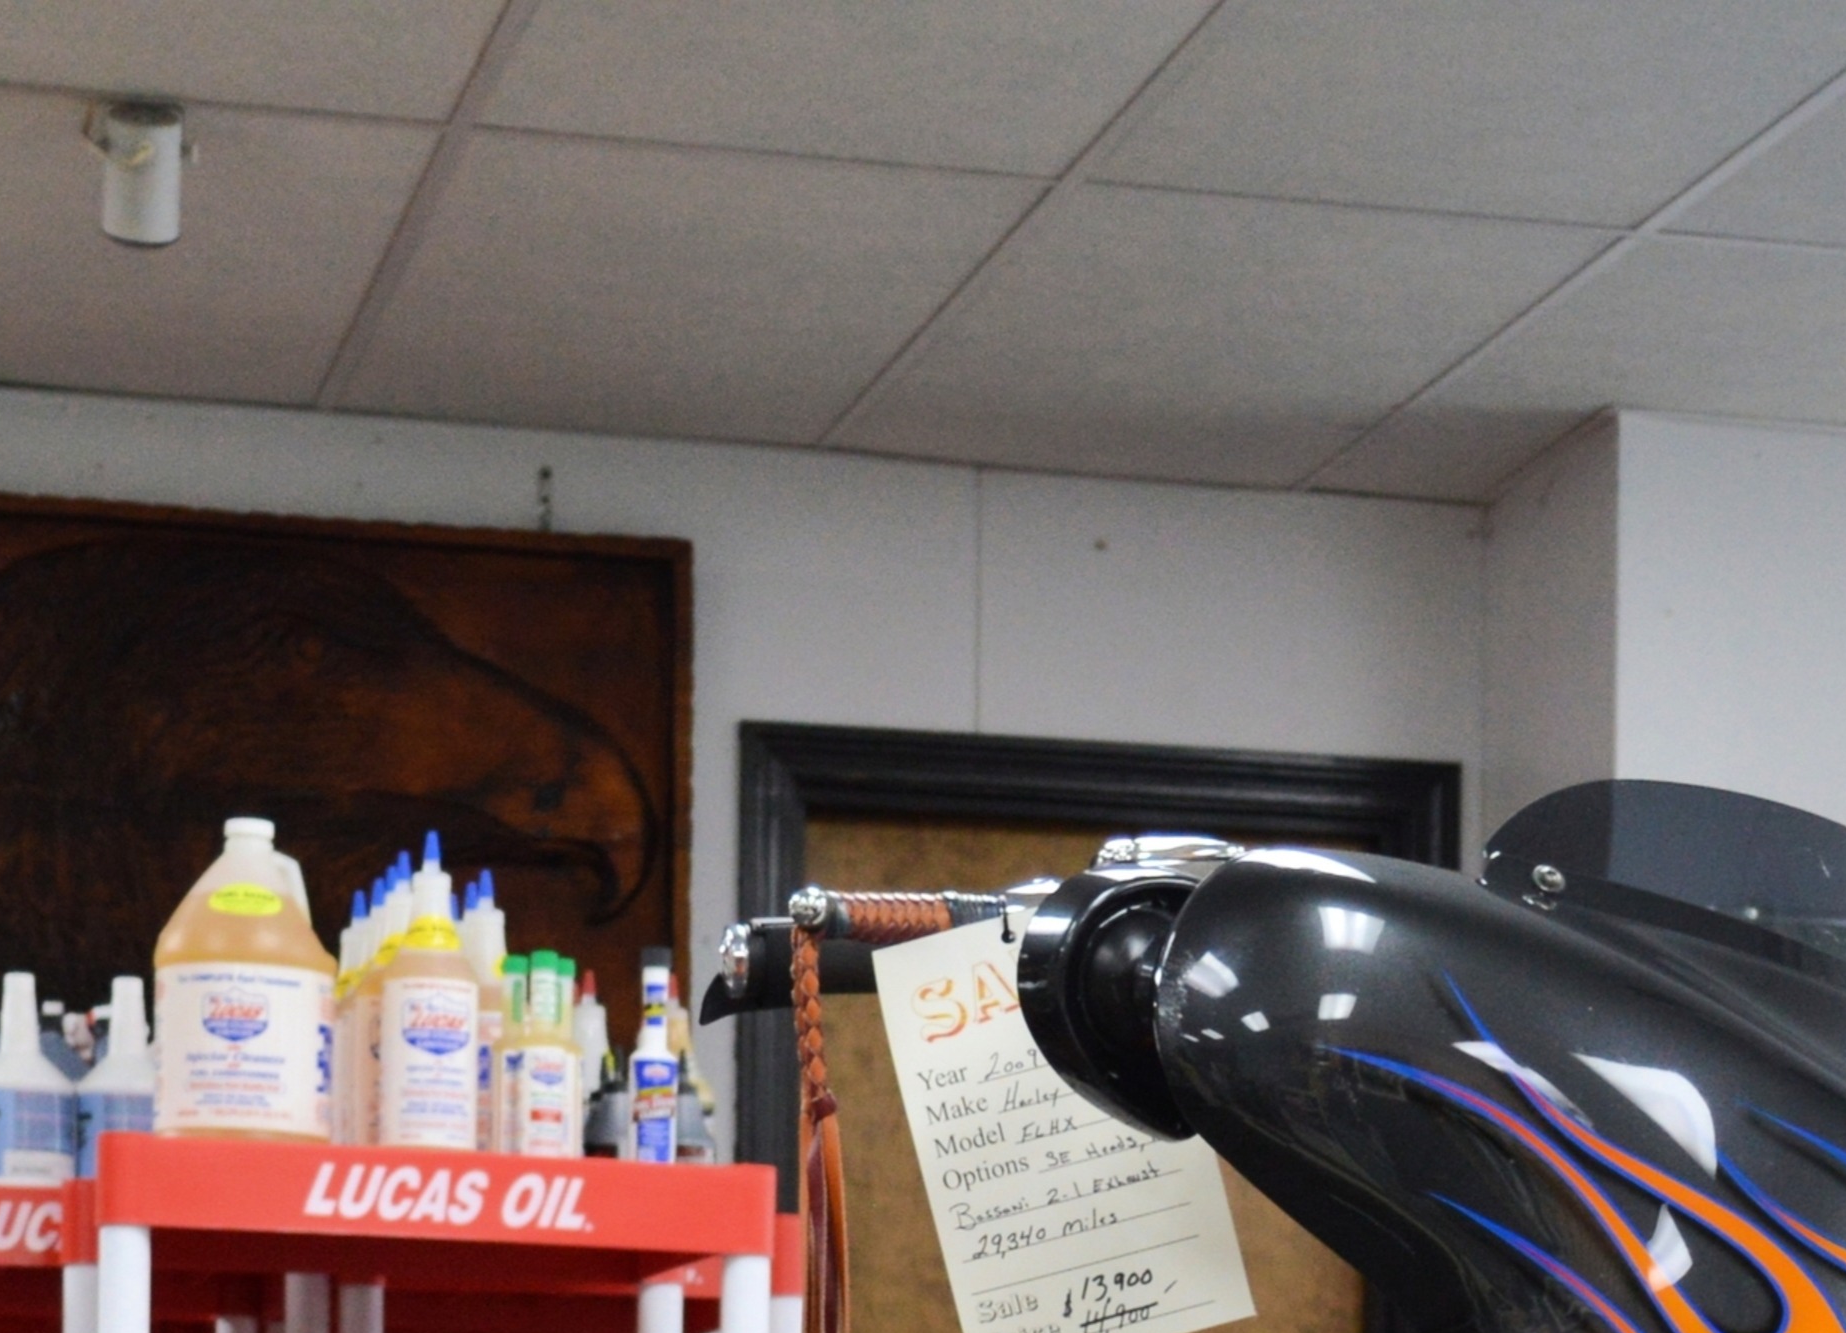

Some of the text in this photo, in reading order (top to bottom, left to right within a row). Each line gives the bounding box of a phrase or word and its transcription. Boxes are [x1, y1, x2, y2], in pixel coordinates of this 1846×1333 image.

[911, 952, 1021, 1043] SA
[918, 1048, 1039, 1092] Year 2009
[925, 1081, 1060, 1125] Make Harley
[935, 1122, 1005, 1158] Model
[943, 1154, 1030, 1191] Options
[303, 1161, 490, 1225] LUCAS
[971, 1225, 1046, 1259] 29,340
[979, 1293, 1039, 1323] Sale
